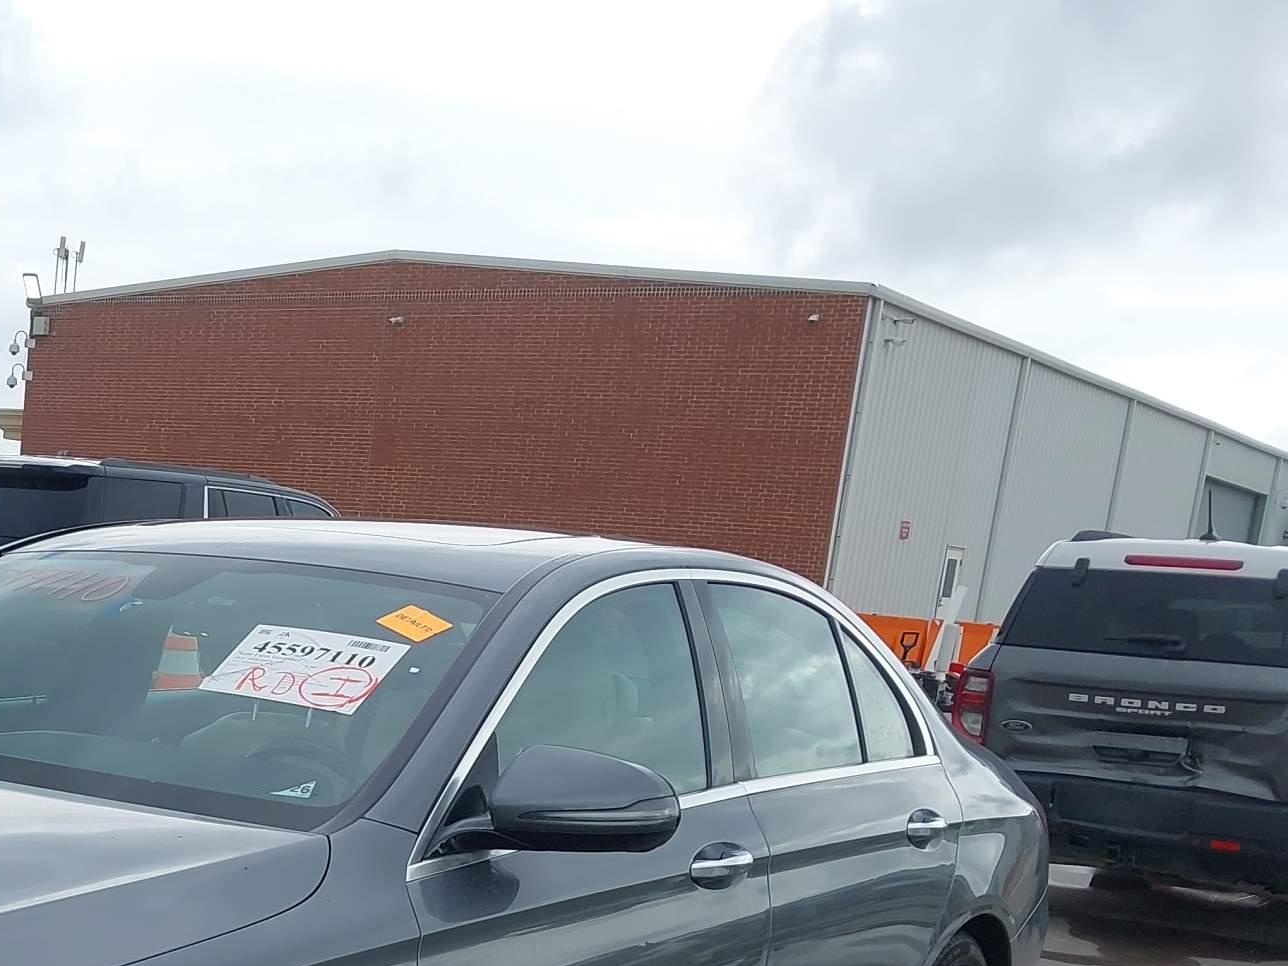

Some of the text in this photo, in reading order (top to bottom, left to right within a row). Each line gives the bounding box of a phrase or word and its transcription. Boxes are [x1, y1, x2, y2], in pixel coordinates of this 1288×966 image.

[253, 640, 376, 668] 45597110
[1068, 692, 1226, 714] BRONCO
[1115, 706, 1174, 717] SPORT
